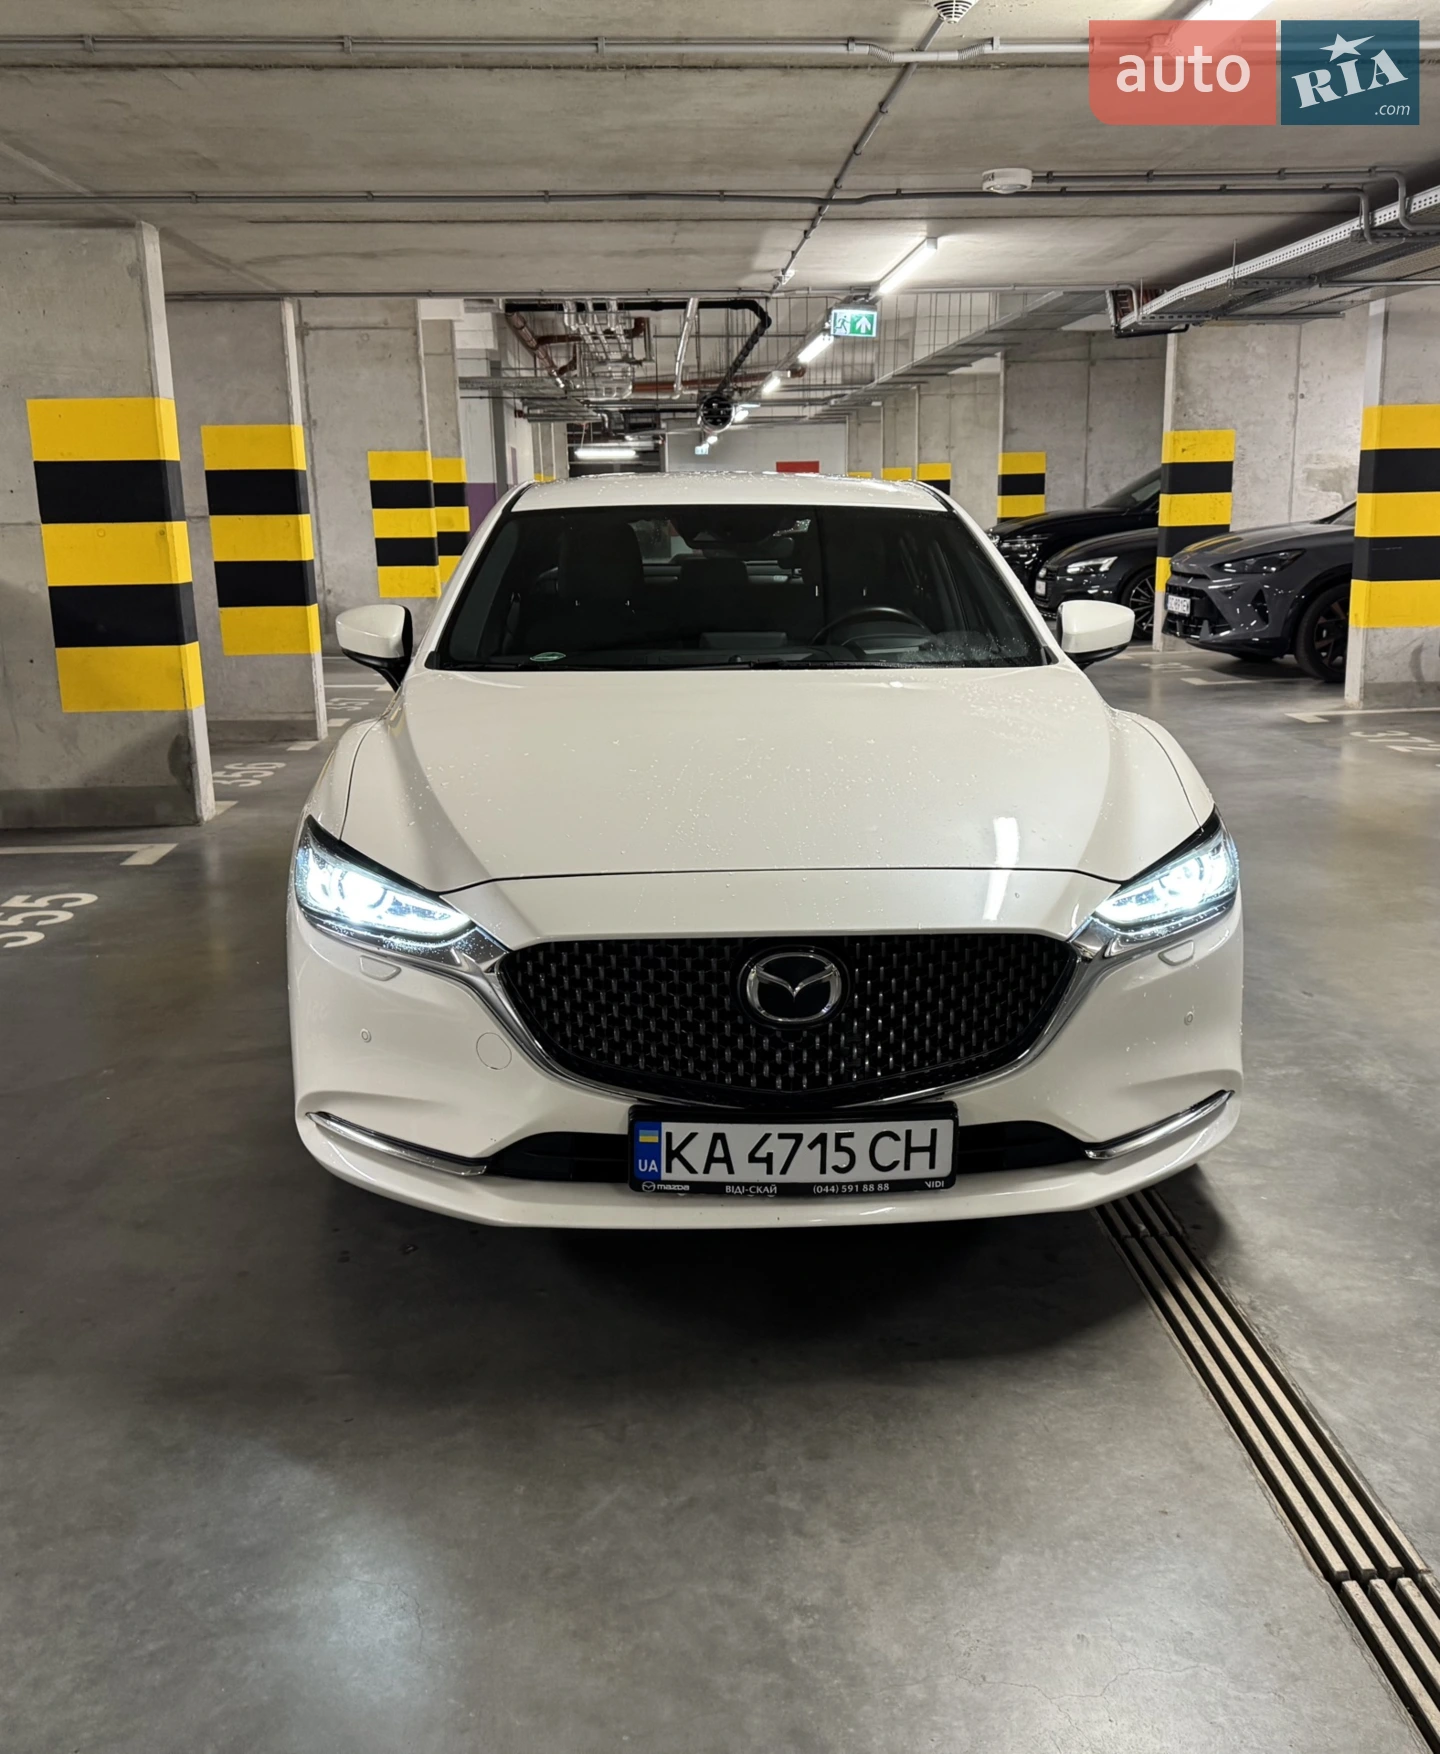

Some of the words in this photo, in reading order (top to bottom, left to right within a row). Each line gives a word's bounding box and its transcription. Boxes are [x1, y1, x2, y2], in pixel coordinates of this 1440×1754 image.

[212, 761, 287, 787] 356
[665, 1131, 735, 1175] KA
[747, 1131, 856, 1175] 4715
[868, 1128, 938, 1173] CH
[638, 1159, 658, 1173] UA
[725, 1184, 778, 1194] ВІДІ-СКАЙ
[813, 1184, 839, 1194] (044)
[841, 1184, 859, 1193] 591
[862, 1183, 875, 1192] 88
[877, 1183, 890, 1191] 88
[925, 1180, 945, 1189] VIDI
